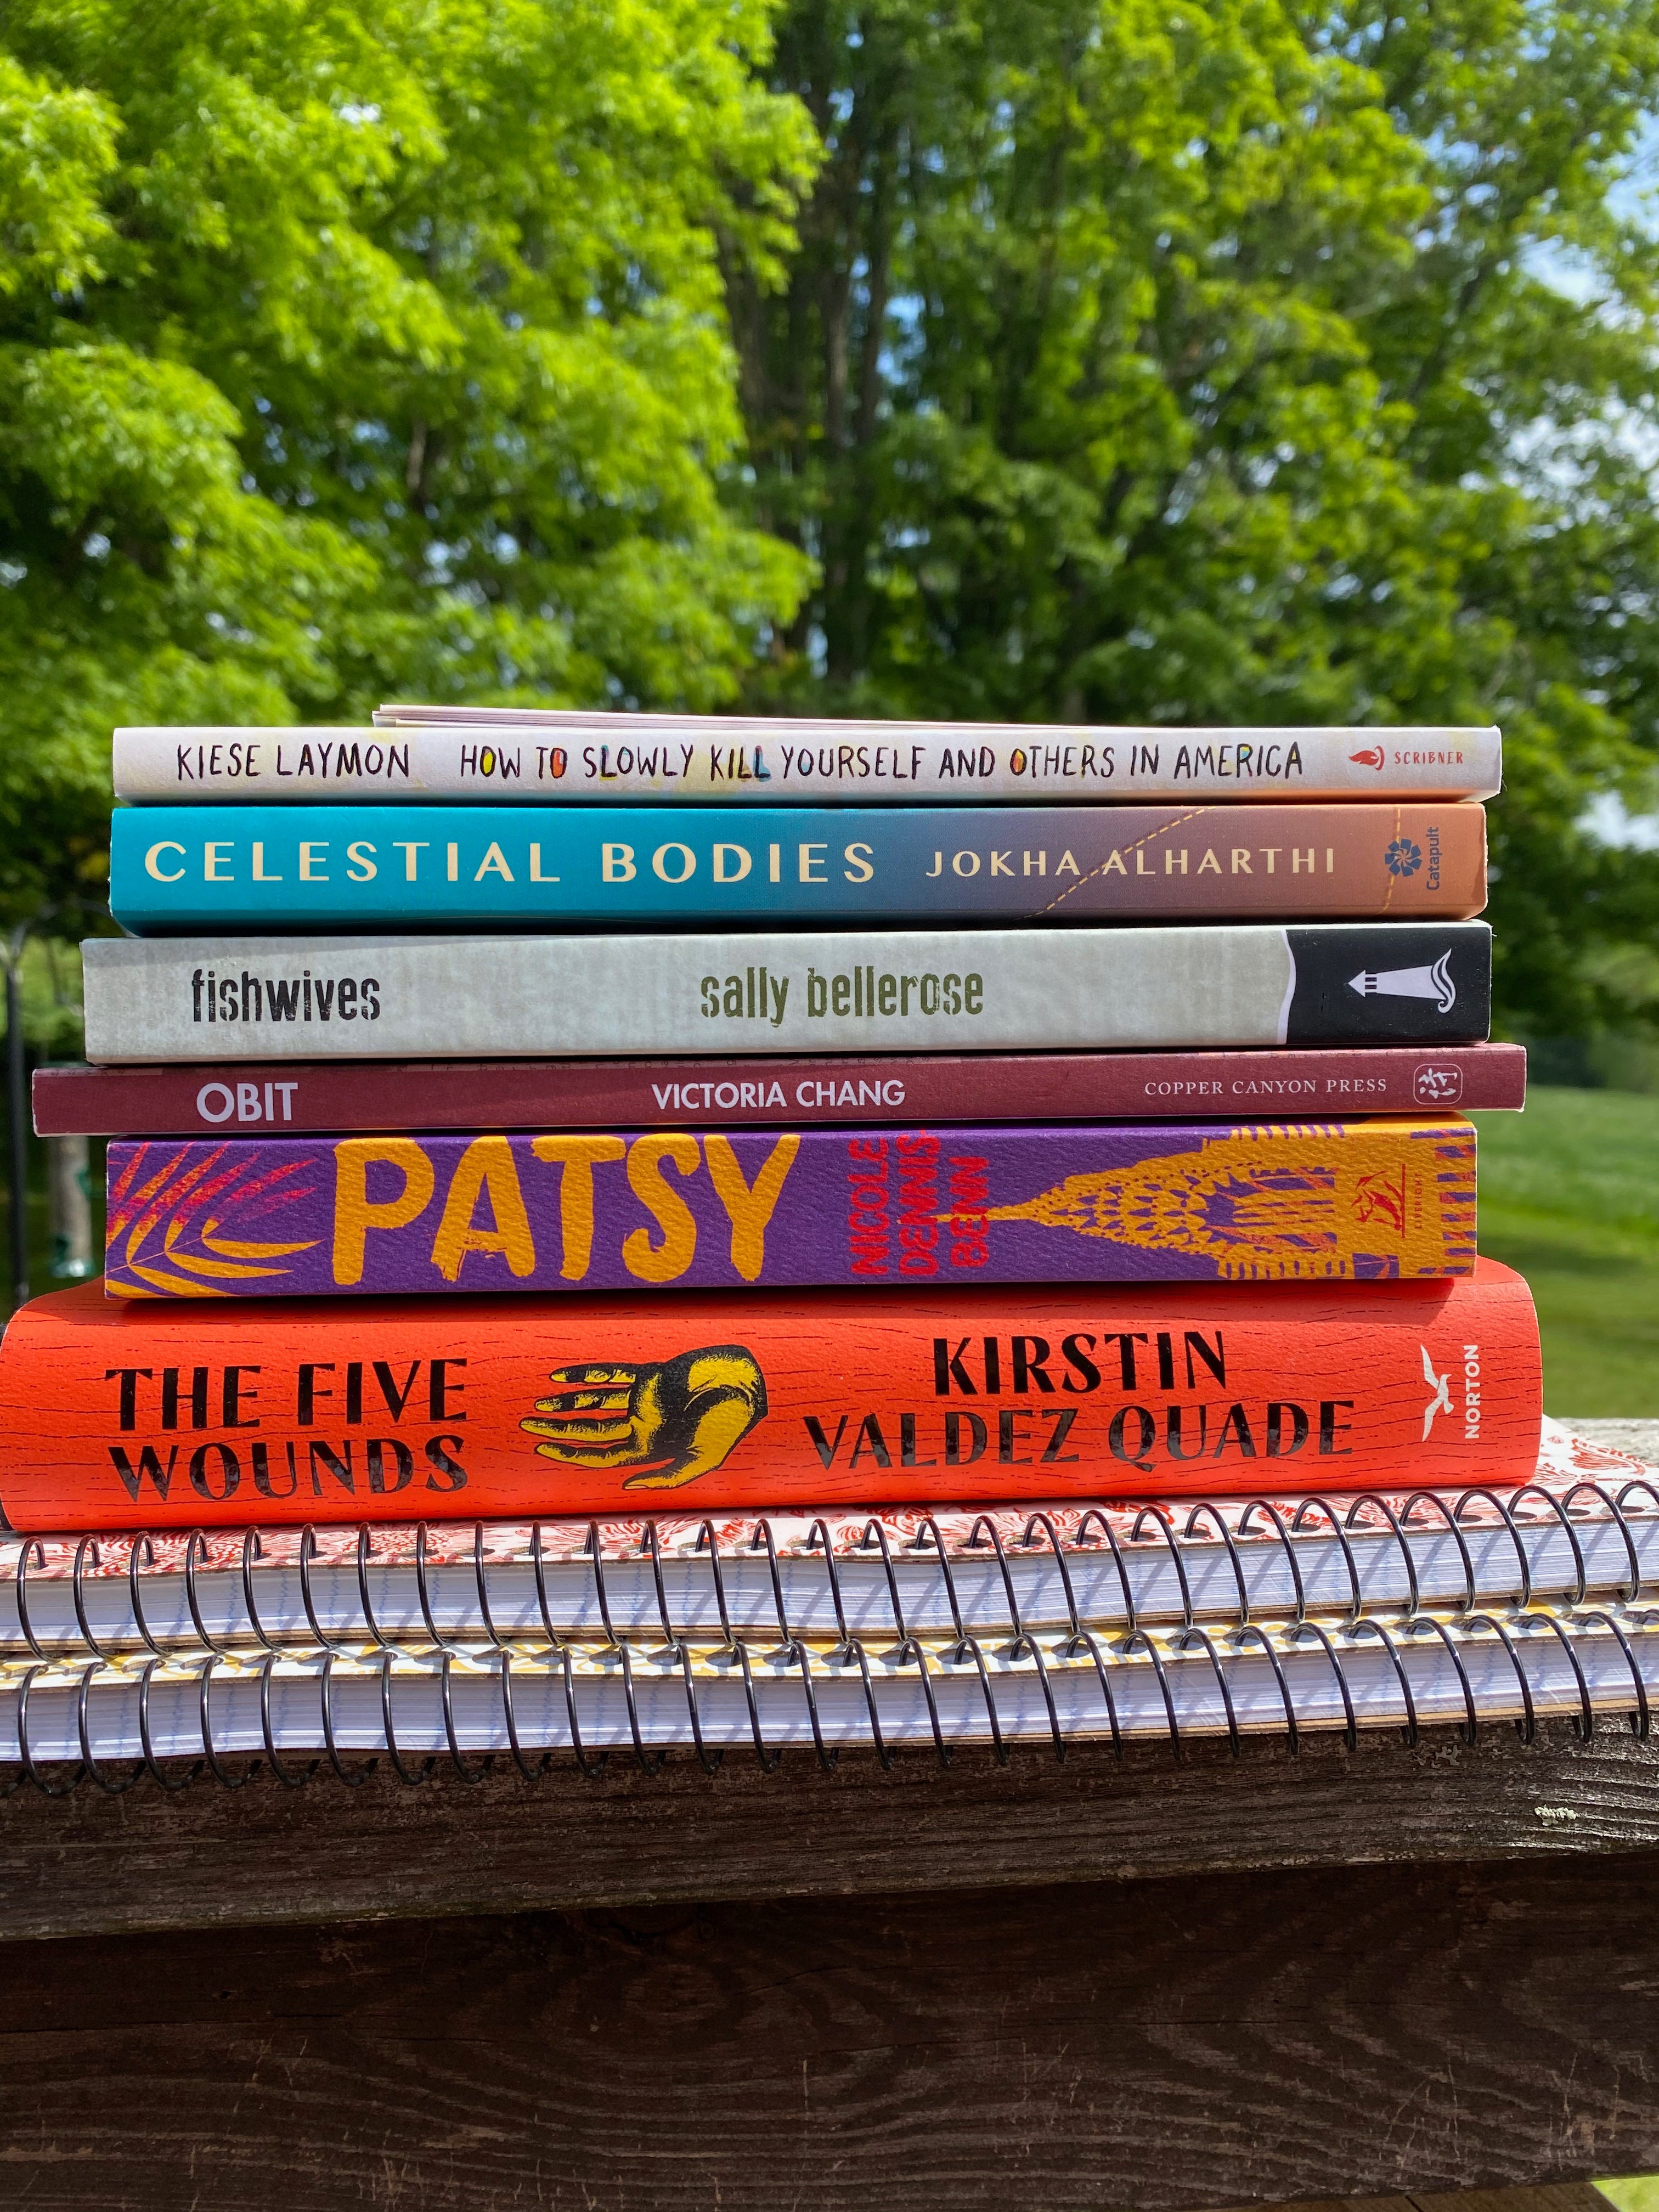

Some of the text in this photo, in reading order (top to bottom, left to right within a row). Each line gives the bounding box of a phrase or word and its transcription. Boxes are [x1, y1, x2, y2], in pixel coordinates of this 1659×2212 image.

[177, 742, 409, 780] KIESE LAYMON
[461, 741, 1302, 781] HOW TO SLOWLY KILL YOURSELF AND OTHERS IN AMERICA
[1394, 751, 1464, 765] SCRIBNER
[144, 840, 874, 883] CELESTIAL BODIES
[926, 848, 1334, 877] JOKHA ALHARTHI
[1426, 827, 1443, 890] Catapult
[192, 969, 380, 1022] fishwives
[701, 966, 983, 1028] sally bellerose
[196, 1082, 298, 1123] OBIT
[651, 1080, 906, 1110] VICTORIA CHANG
[1144, 1078, 1387, 1096] COPPER CANYON PRESS
[332, 1133, 801, 1285] PATSY
[848, 1137, 890, 1275] NICOLE
[949, 1156, 990, 1267] BENN
[933, 1330, 1227, 1395] KIRSTIN
[1464, 1344, 1480, 1440] NORTON
[105, 1358, 467, 1430] THE FIVE
[803, 1400, 1355, 1473] VALDEZ QUADE
[108, 1435, 468, 1502] WOUNDS
